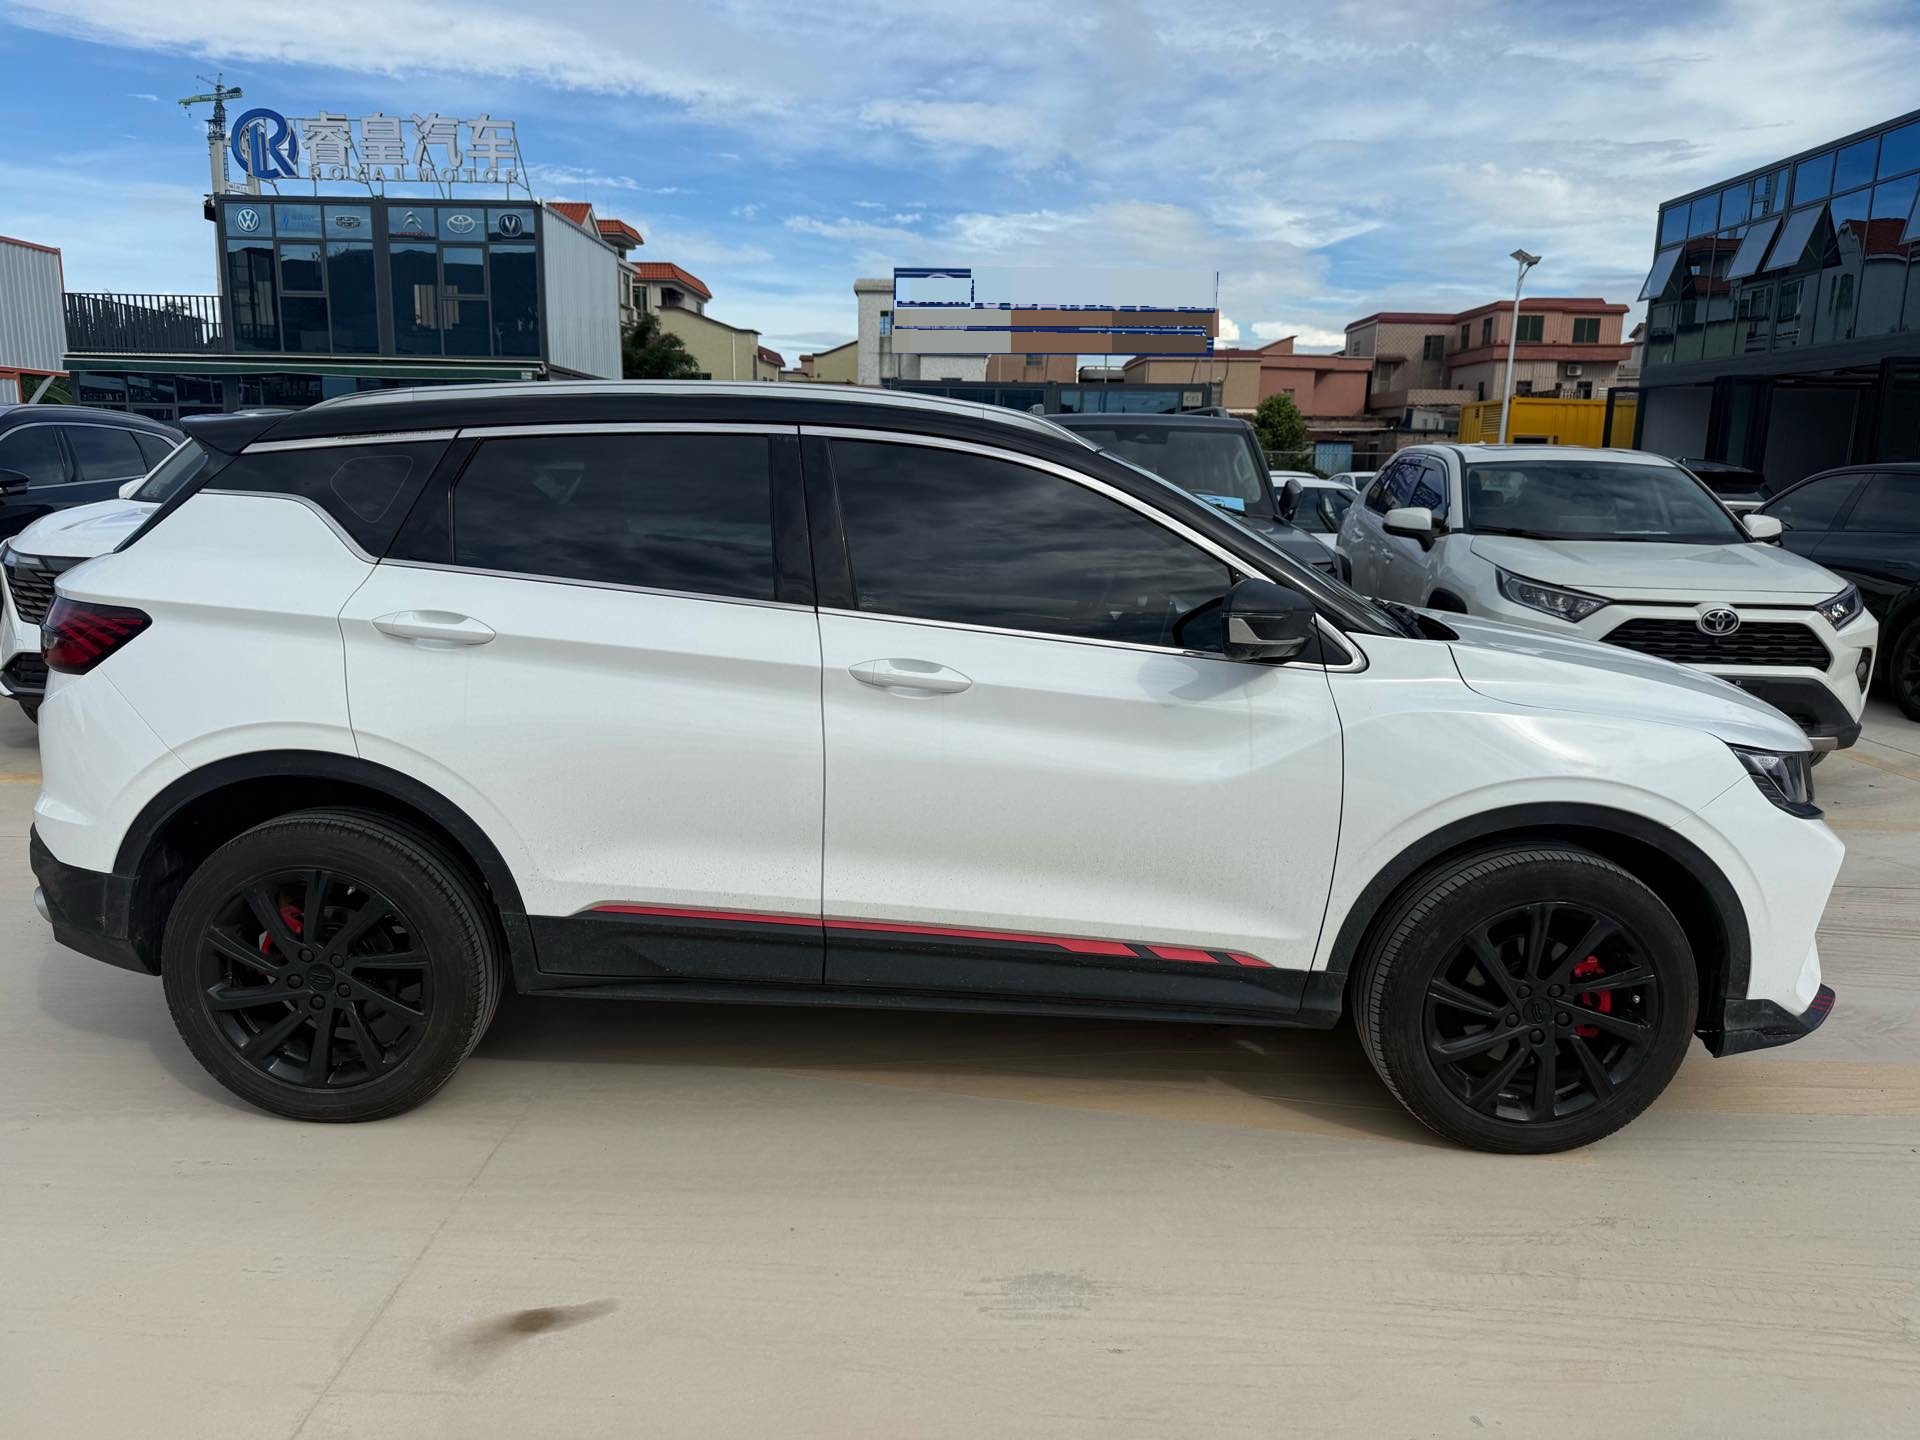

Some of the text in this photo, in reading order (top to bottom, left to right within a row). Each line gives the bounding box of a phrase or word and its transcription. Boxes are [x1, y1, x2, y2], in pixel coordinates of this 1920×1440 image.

[302, 111, 517, 169] 睿皇汽车
[308, 165, 520, 184] ROYAL MOTOR
